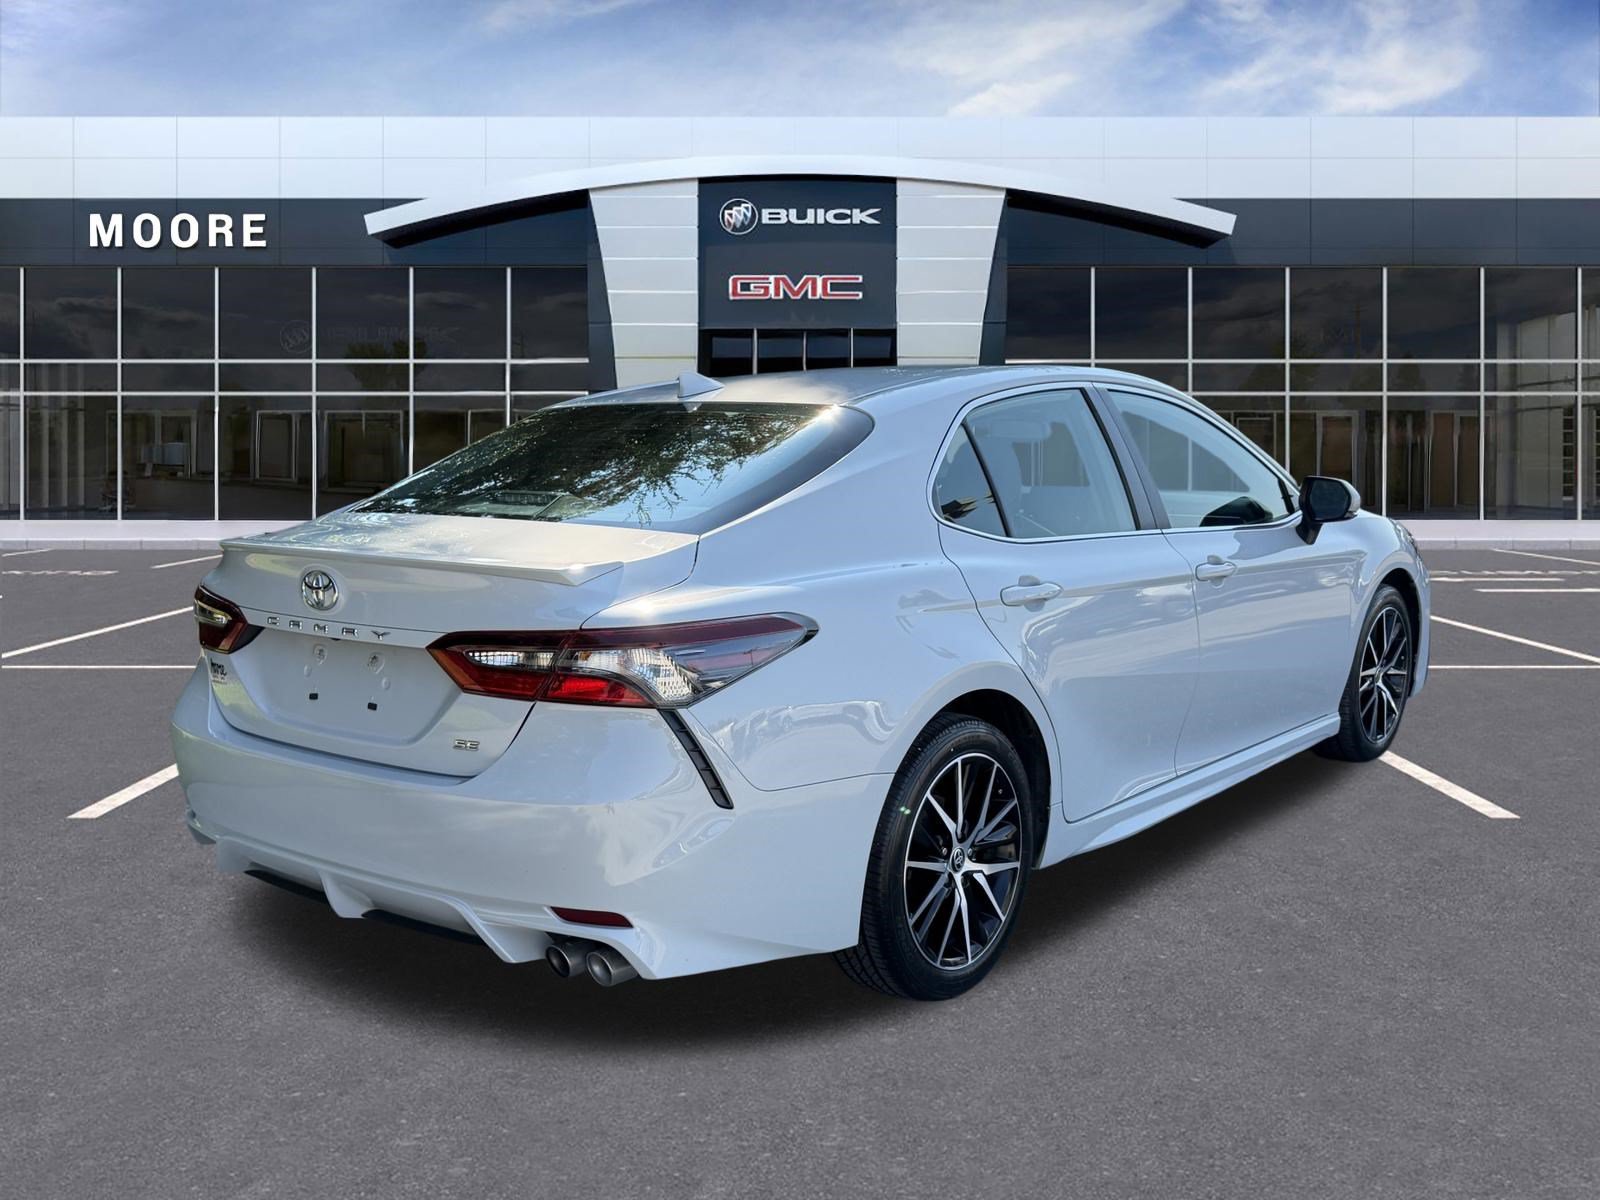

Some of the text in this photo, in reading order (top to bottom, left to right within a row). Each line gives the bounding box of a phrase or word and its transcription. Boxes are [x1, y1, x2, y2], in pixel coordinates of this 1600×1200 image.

[761, 208, 882, 225] BUICK
[89, 212, 267, 249] MOORE
[728, 274, 863, 300] GMC
[266, 616, 391, 641] CAMRY
[453, 739, 481, 751] SE
